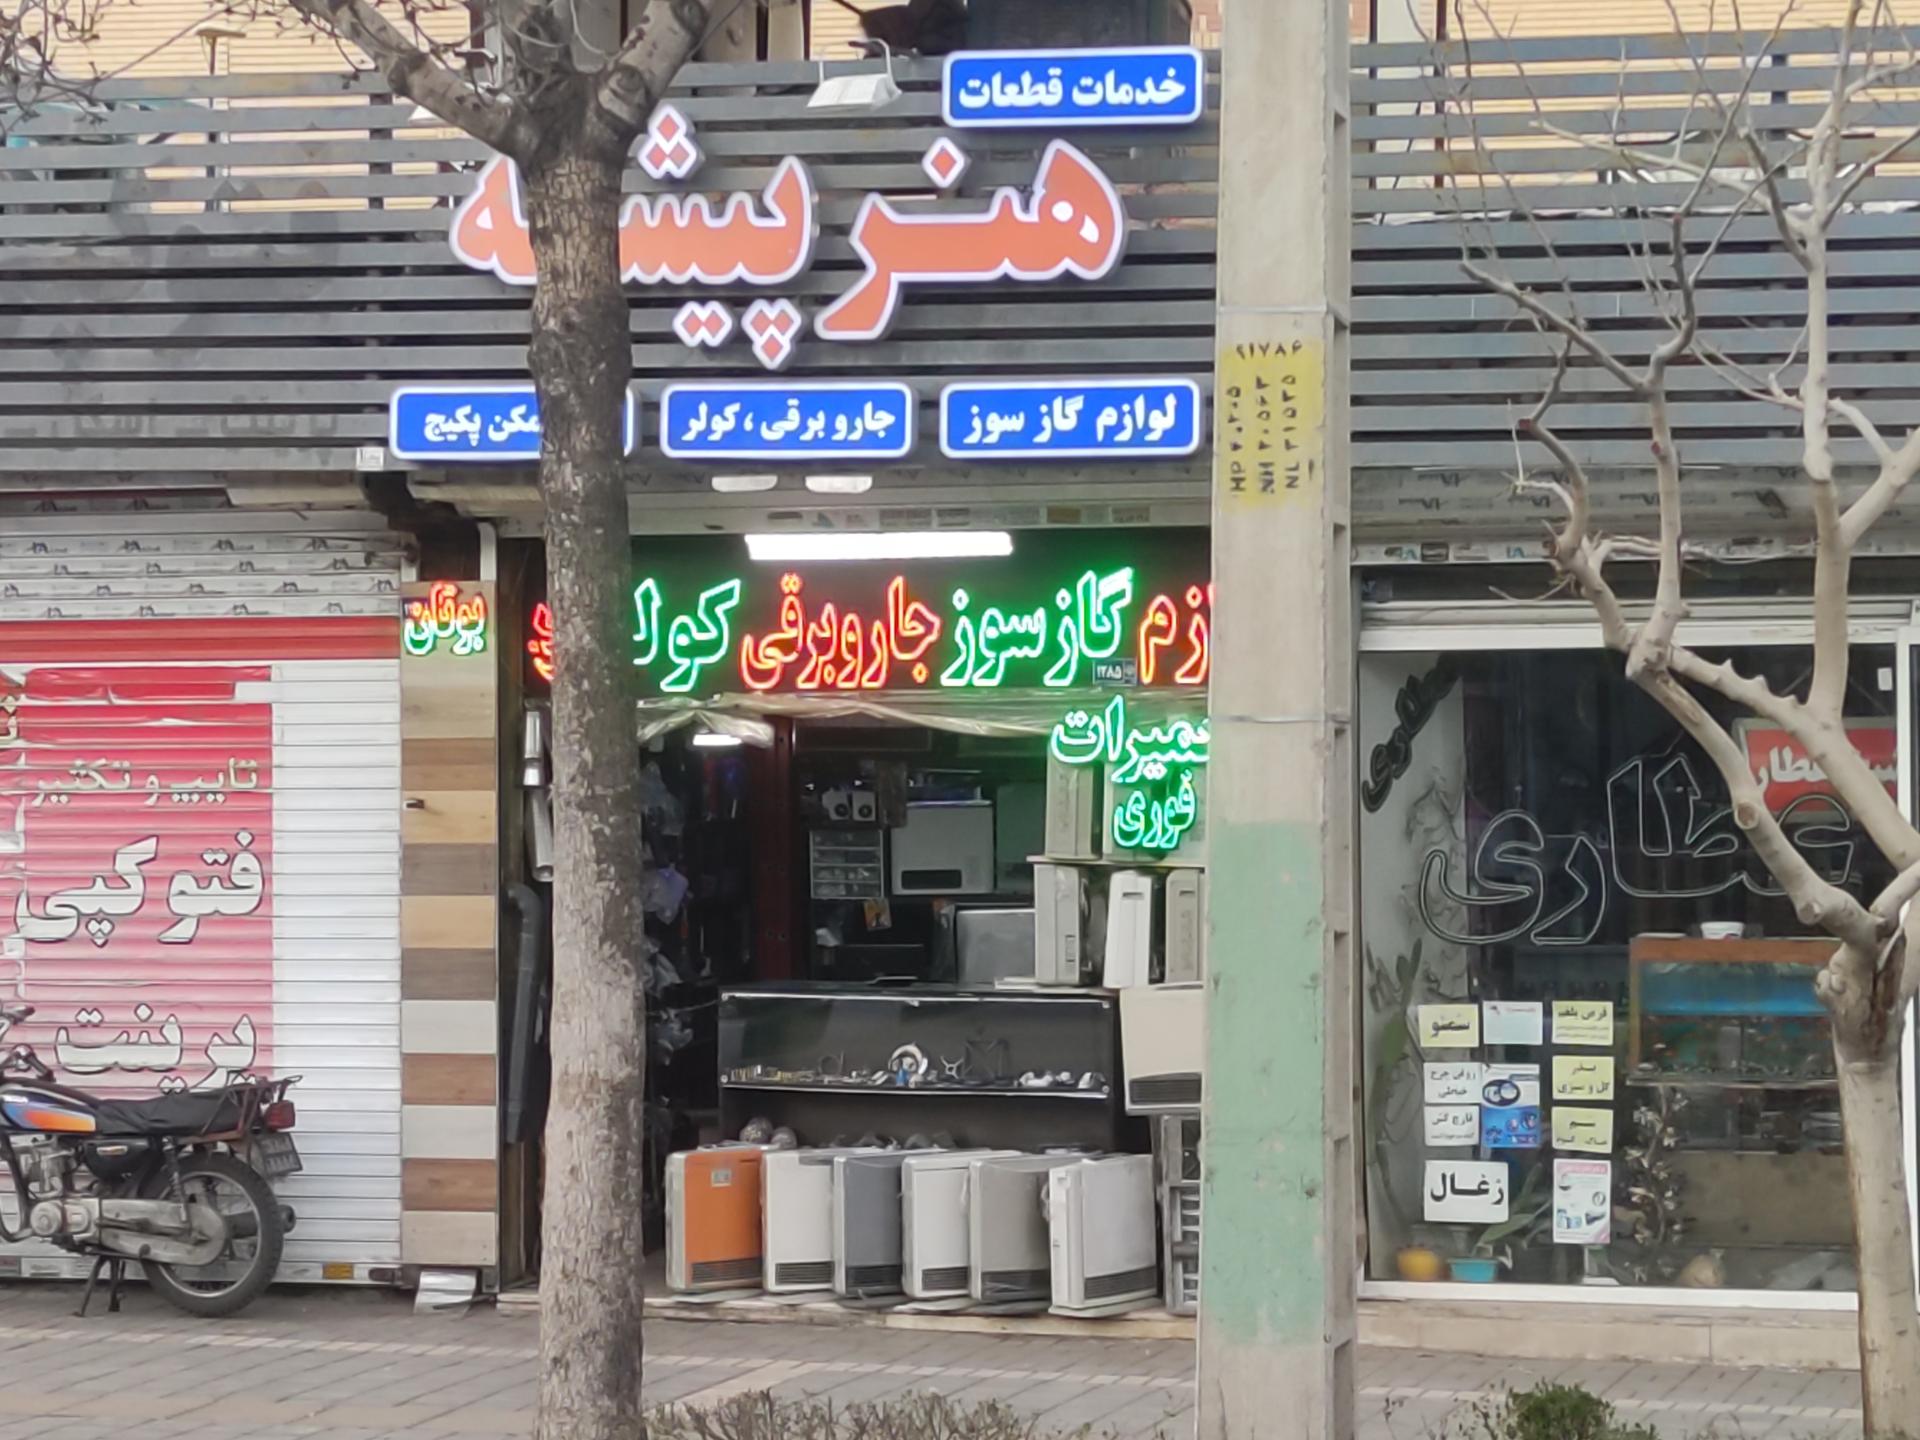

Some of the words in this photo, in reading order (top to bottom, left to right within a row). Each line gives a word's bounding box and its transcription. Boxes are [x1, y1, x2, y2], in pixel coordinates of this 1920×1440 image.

[958, 66, 1063, 109] قطعات
[1071, 66, 1187, 106] خدمات
[423, 404, 483, 448] پکیج
[680, 400, 742, 442] کولر
[962, 404, 1026, 445] سوز
[1032, 394, 1085, 444] گاز
[1096, 392, 1178, 443] لوازم
[1284, 461, 1300, 489] NL
[632, 577, 741, 692] کول
[1050, 694, 1211, 784] میرات
[30, 757, 132, 808] تکثیر
[143, 774, 160, 806] و
[169, 756, 258, 804] تایپ
[1112, 768, 1196, 849] فوری
[1430, 1171, 1505, 1205] زغال
